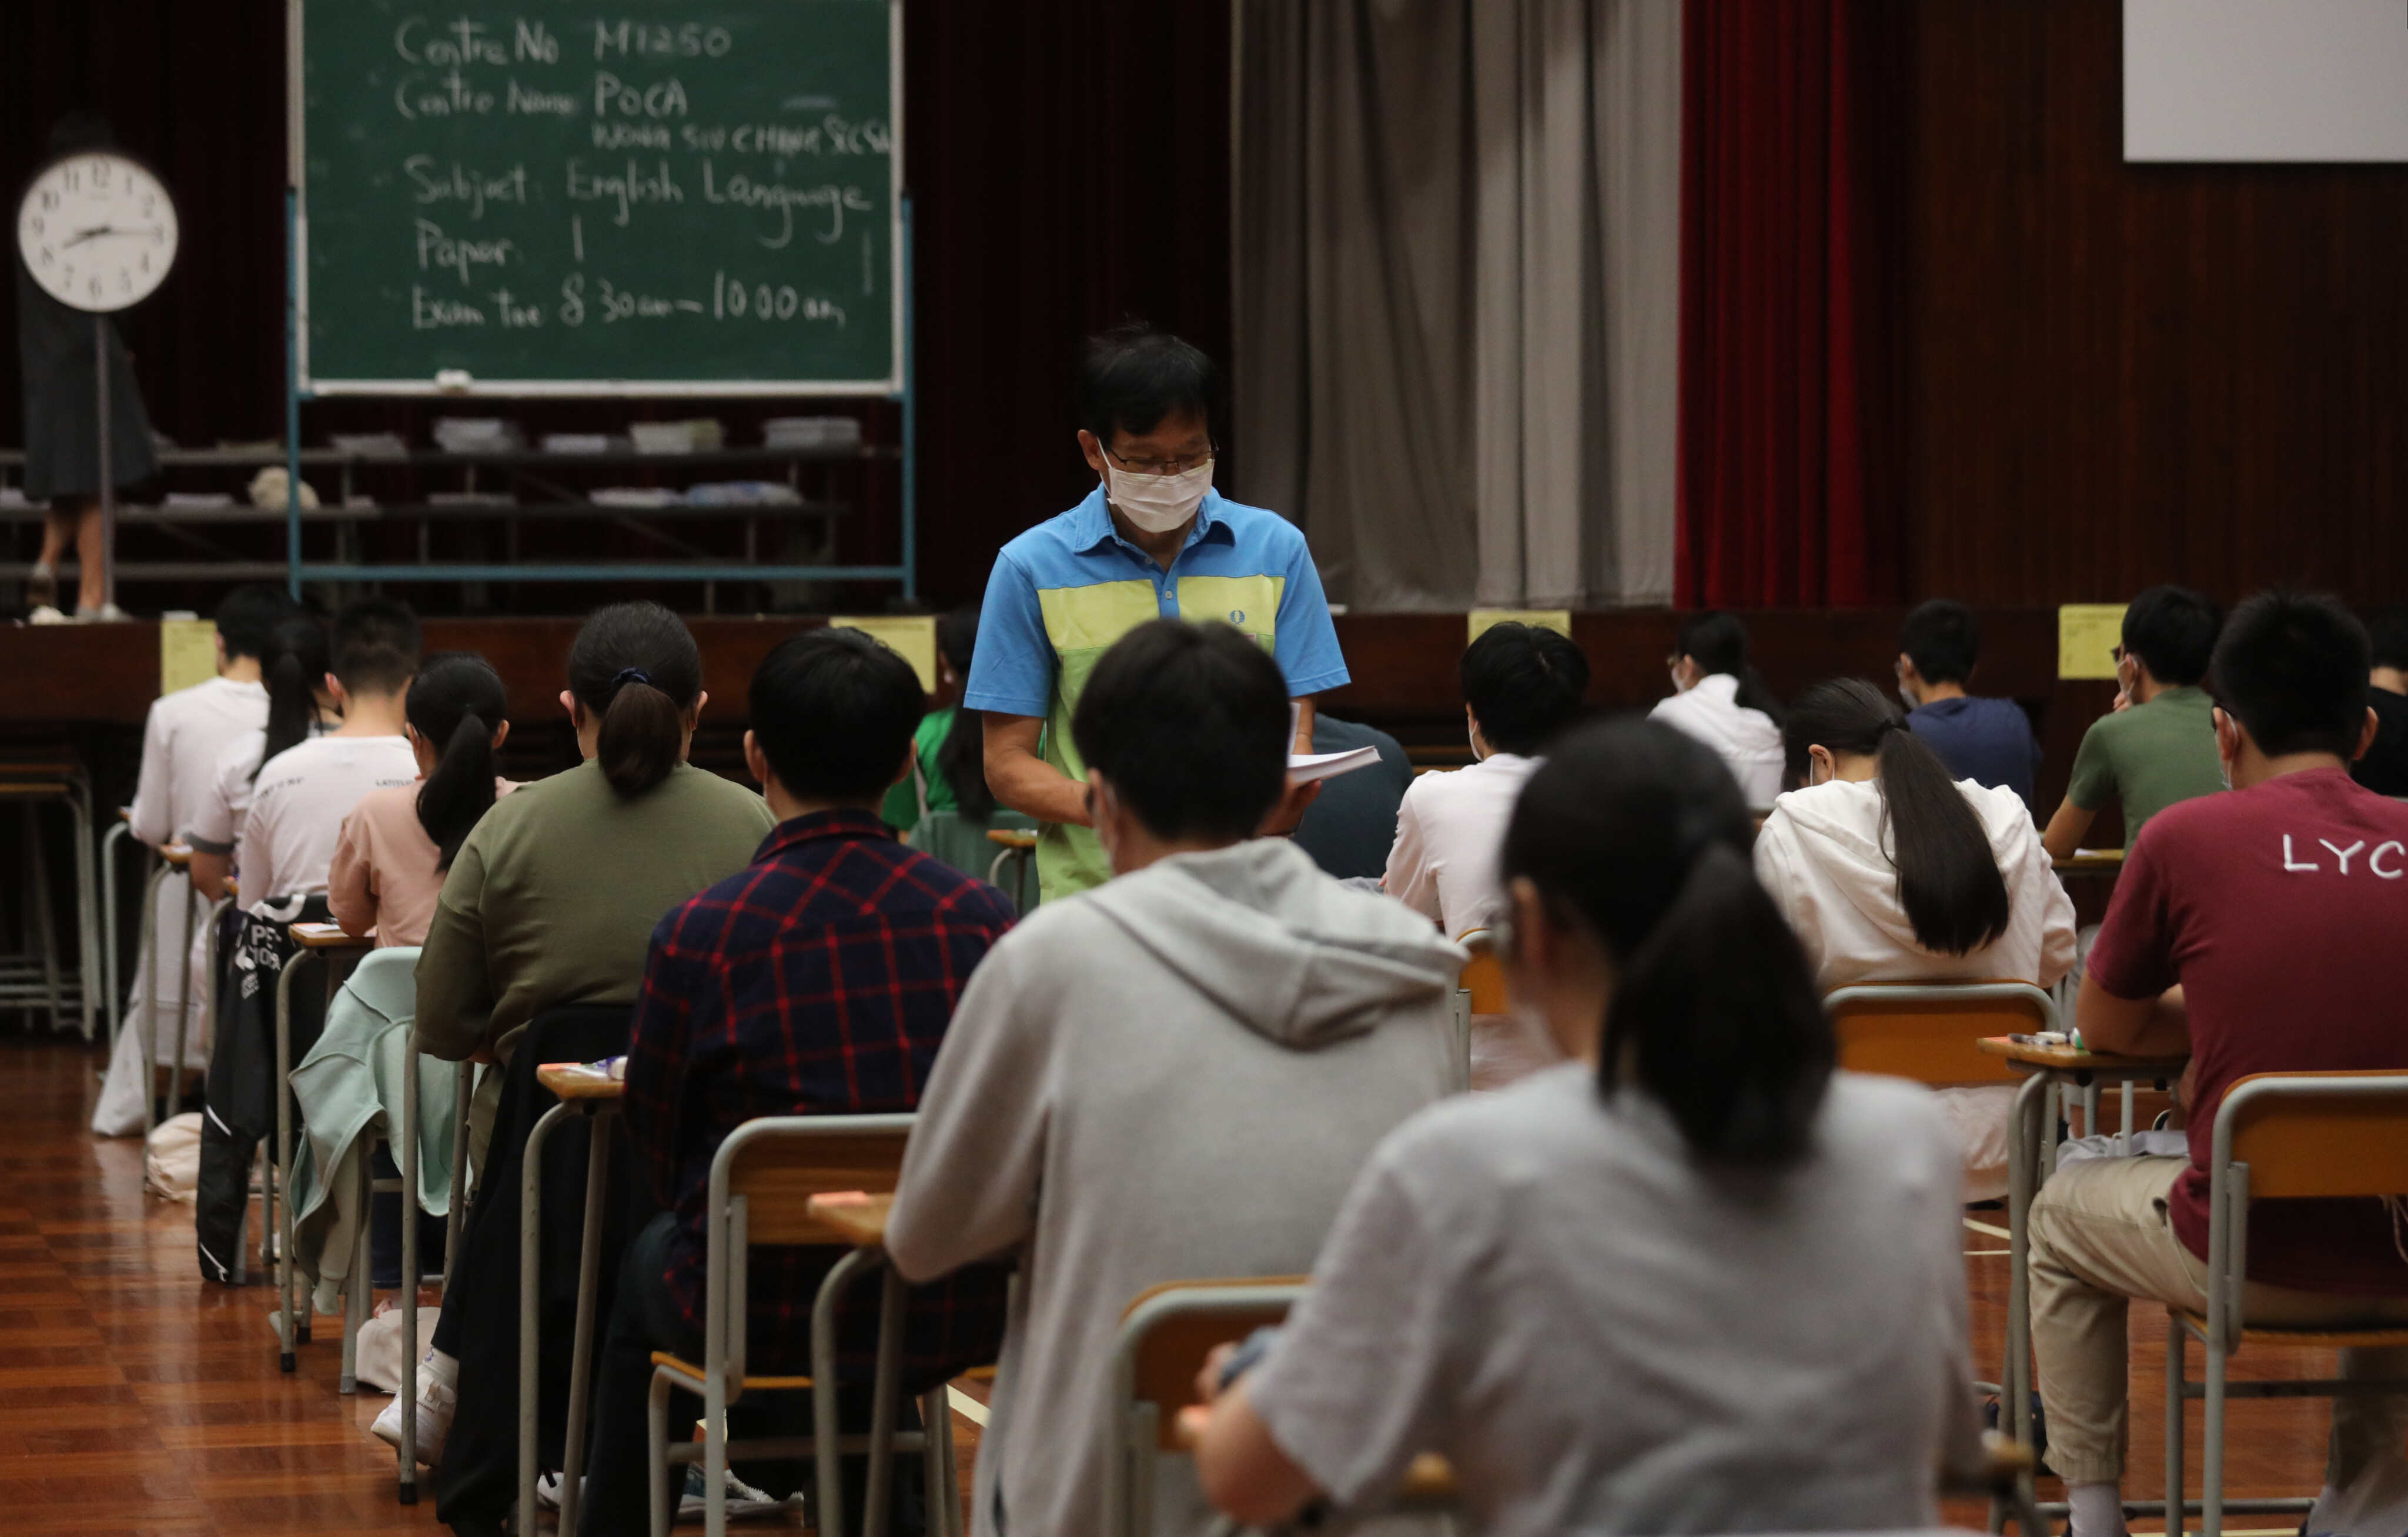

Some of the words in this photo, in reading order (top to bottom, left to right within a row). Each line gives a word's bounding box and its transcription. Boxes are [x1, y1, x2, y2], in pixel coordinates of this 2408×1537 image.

[404, 155, 525, 220] Subject
[566, 158, 684, 227] English
[703, 158, 873, 249] Language
[416, 217, 513, 286] Paper
[2283, 833, 2406, 879] LYC
